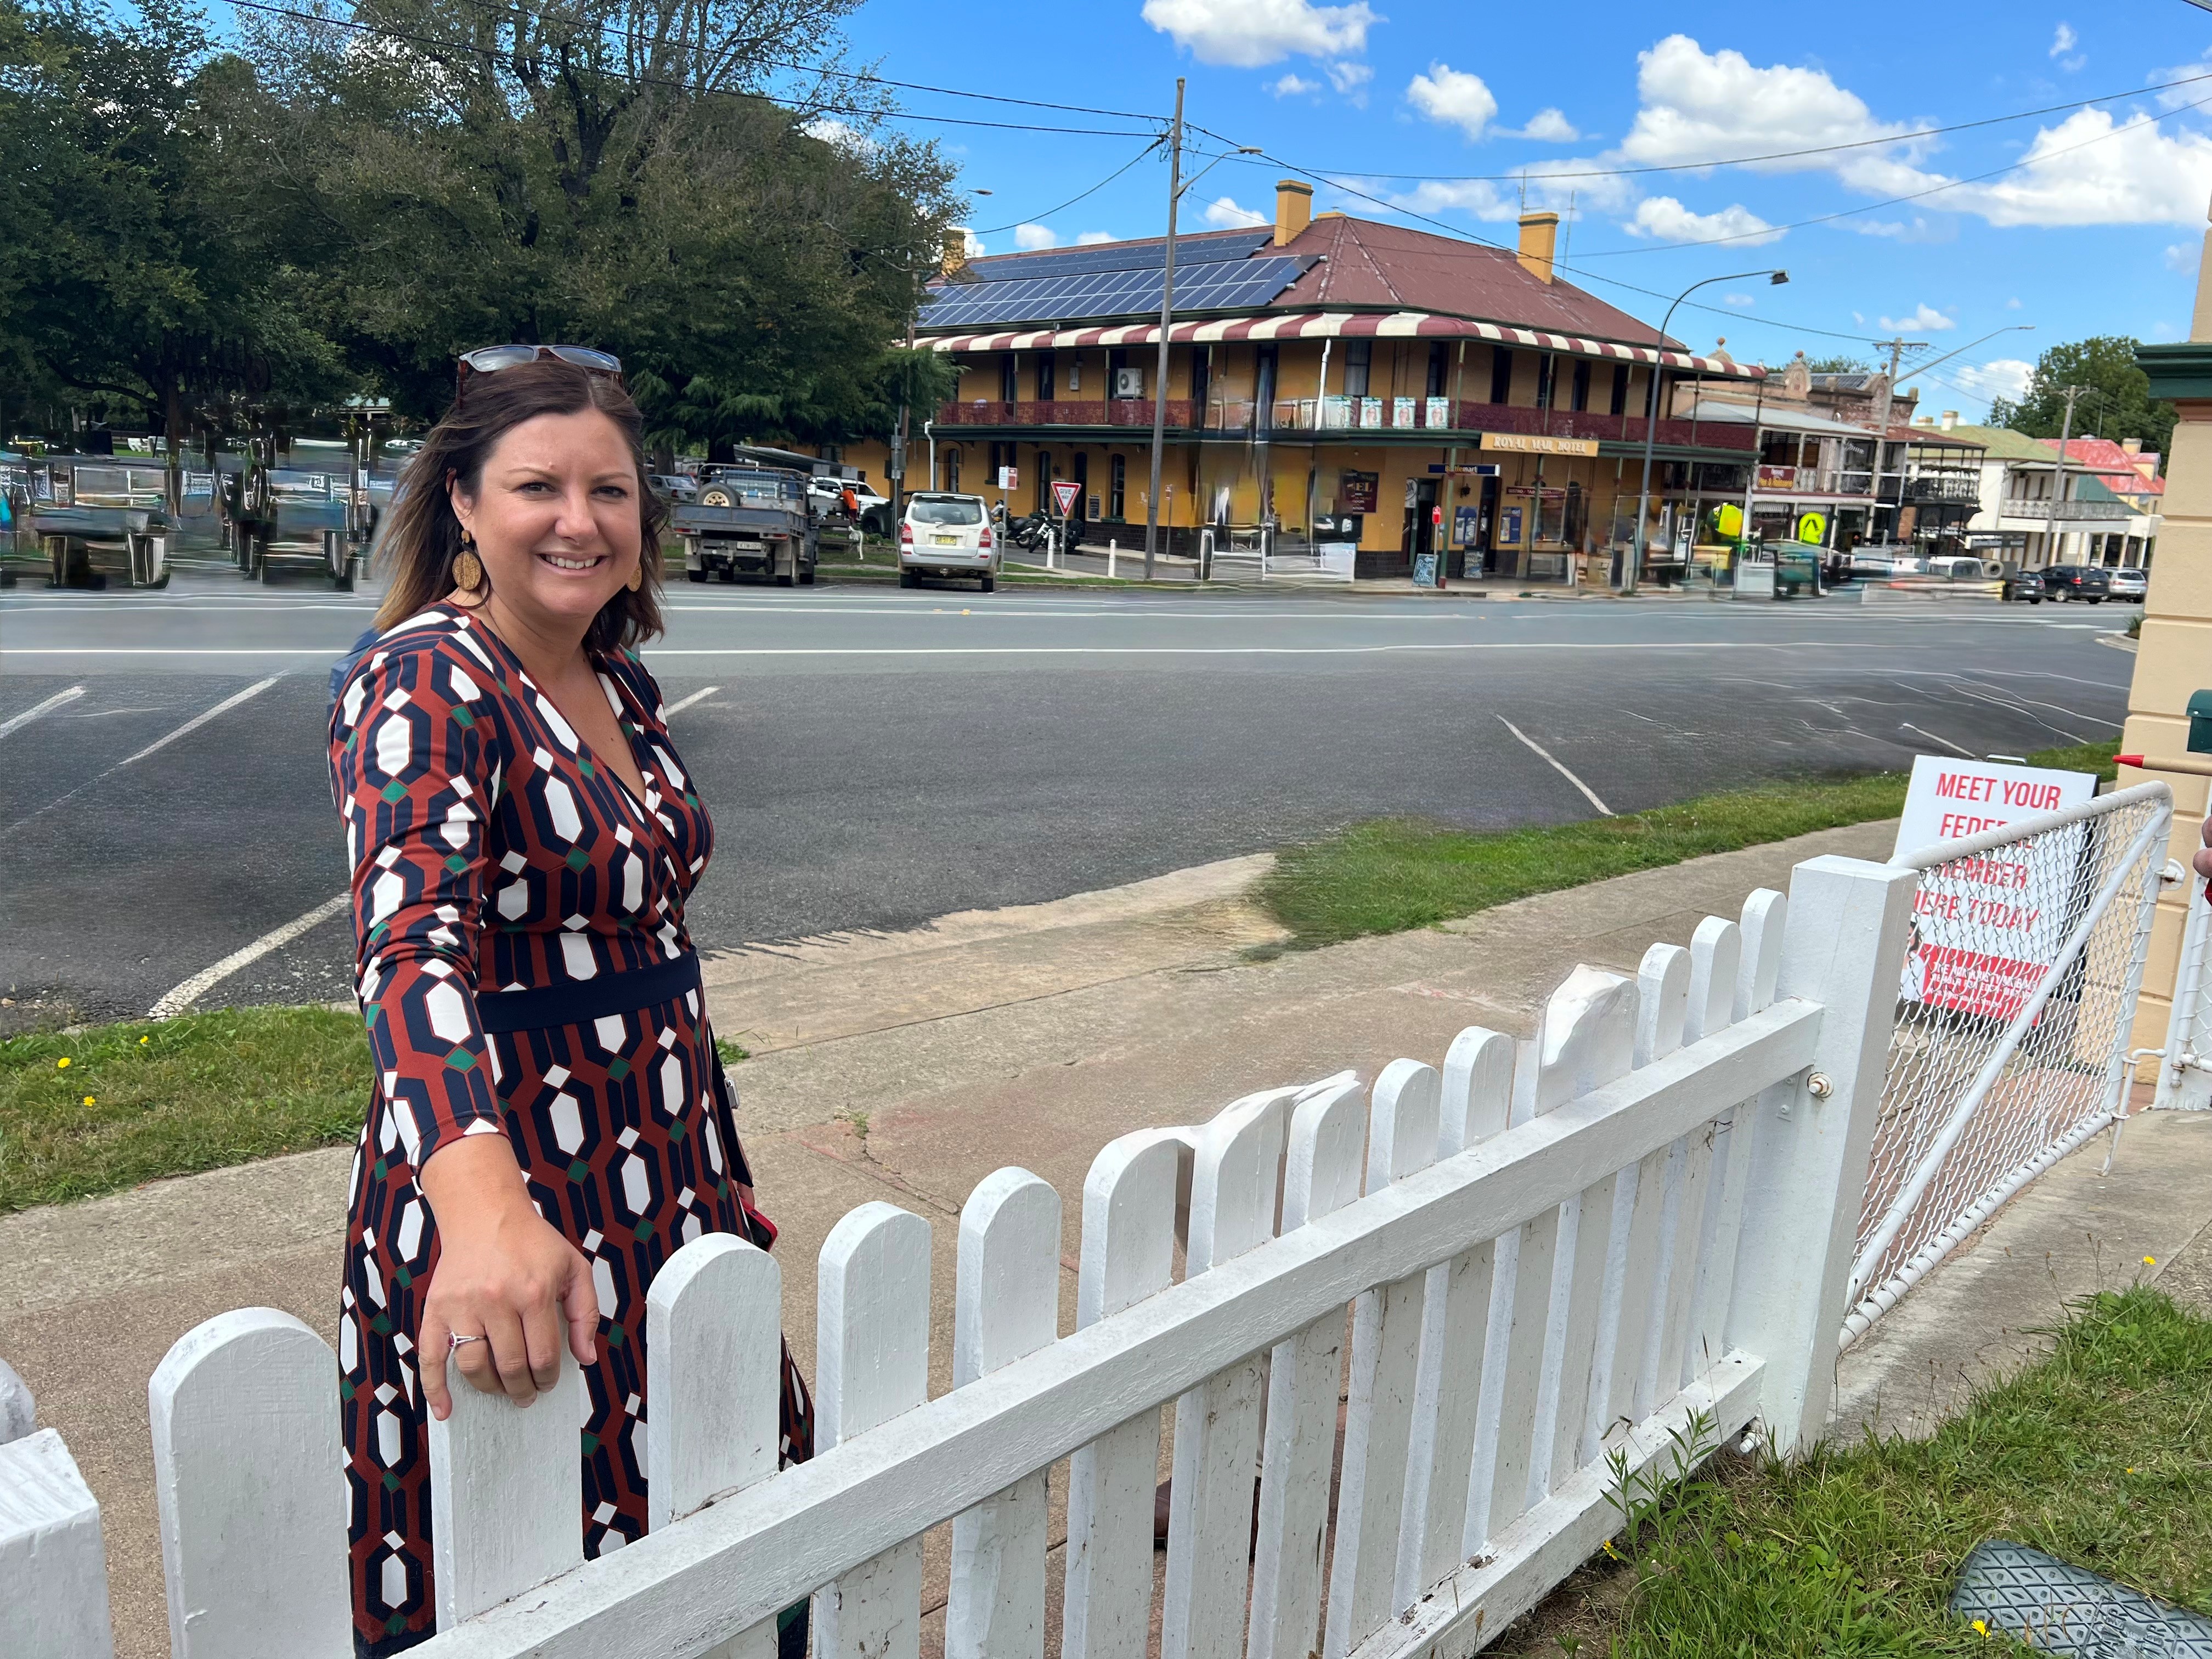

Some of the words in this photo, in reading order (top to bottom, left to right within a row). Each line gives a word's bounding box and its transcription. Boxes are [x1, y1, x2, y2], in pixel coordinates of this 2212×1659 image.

[1493, 436, 1526, 450] ROYAL
[1531, 439, 1553, 453] MAIL
[1557, 441, 1586, 454] HOTEL
[1936, 772, 1997, 802] MEET
[2003, 780, 2062, 810] YOUR
[1932, 856, 2027, 890] MEMBER
[1968, 898, 2040, 933] TODAY
